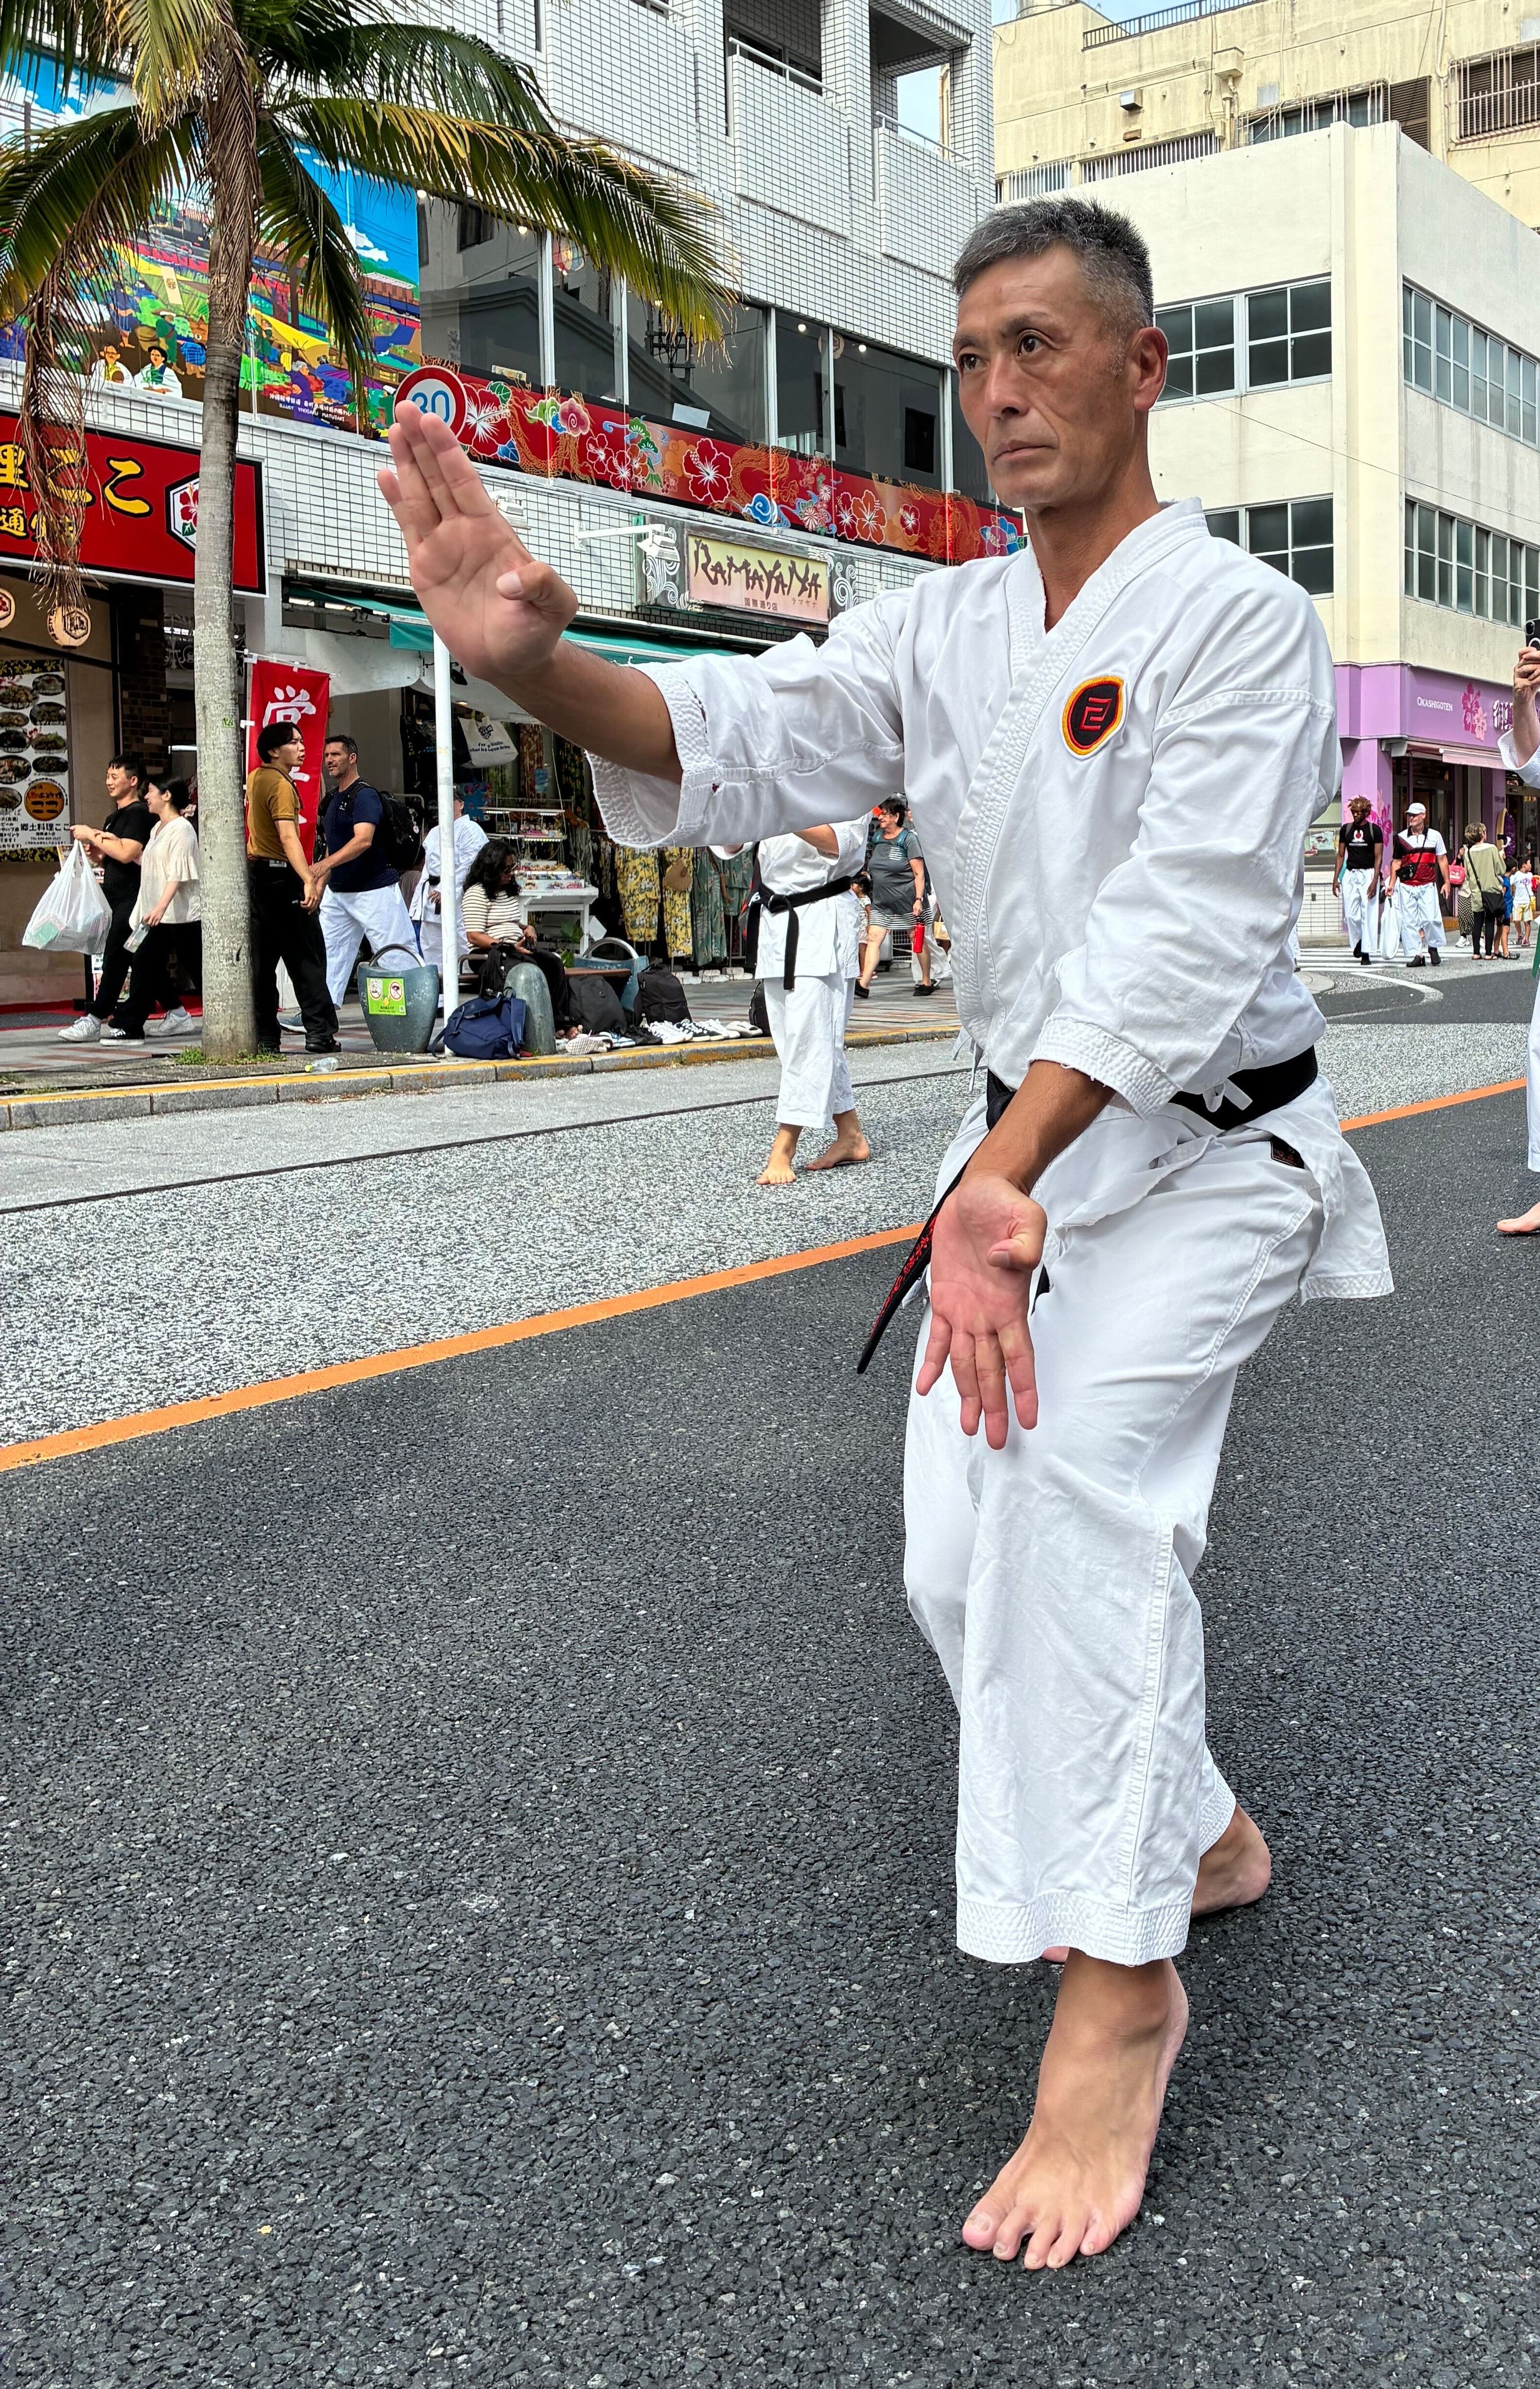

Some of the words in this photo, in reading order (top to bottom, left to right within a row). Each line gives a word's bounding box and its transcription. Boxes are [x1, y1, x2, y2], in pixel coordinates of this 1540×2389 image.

[411, 390, 450, 425] 30
[694, 539, 822, 600] RAMAYANA
[744, 597, 778, 610] 国際通り店
[1417, 696, 1453, 712] OKASHIGOTEN
